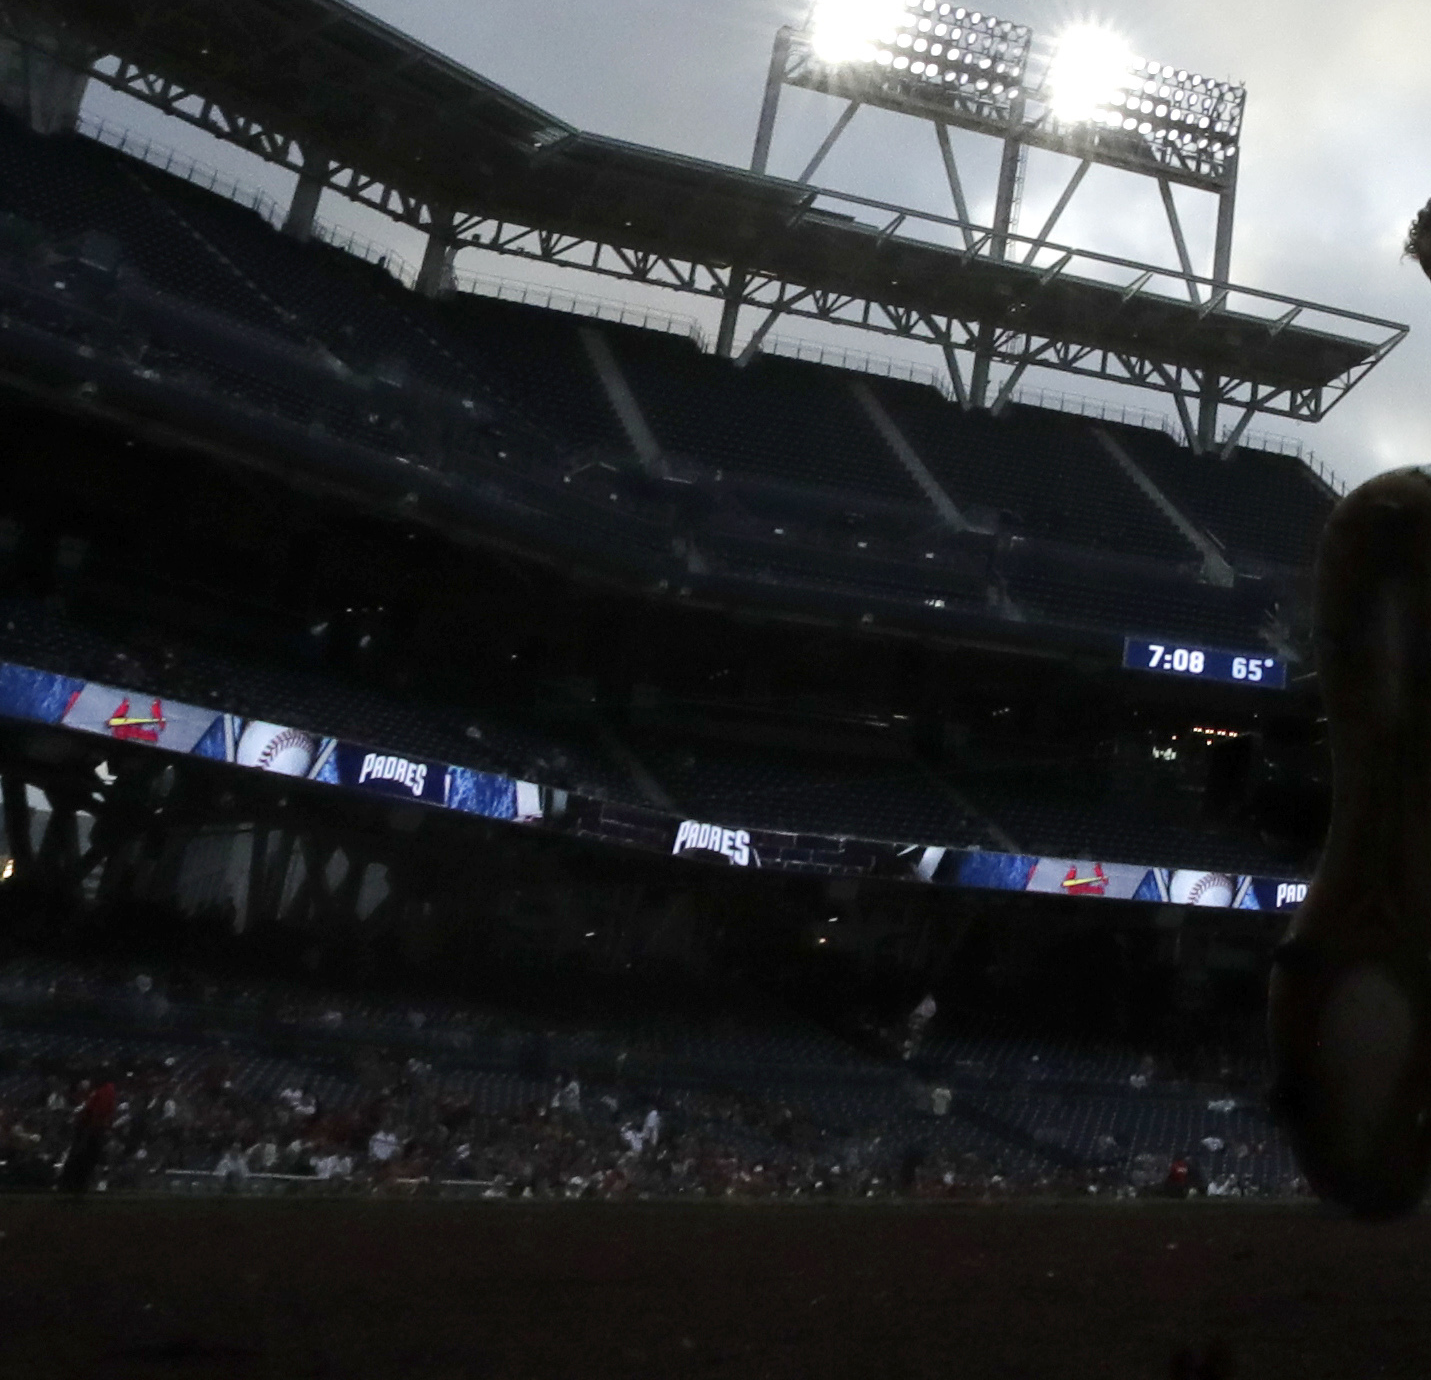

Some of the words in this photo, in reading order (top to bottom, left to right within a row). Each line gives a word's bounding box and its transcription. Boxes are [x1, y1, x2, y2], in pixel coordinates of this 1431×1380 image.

[1147, 644, 1205, 674] 7:08
[1231, 656, 1275, 682] 65°
[358, 753, 428, 798] PADRES
[671, 818, 752, 867] PADRES
